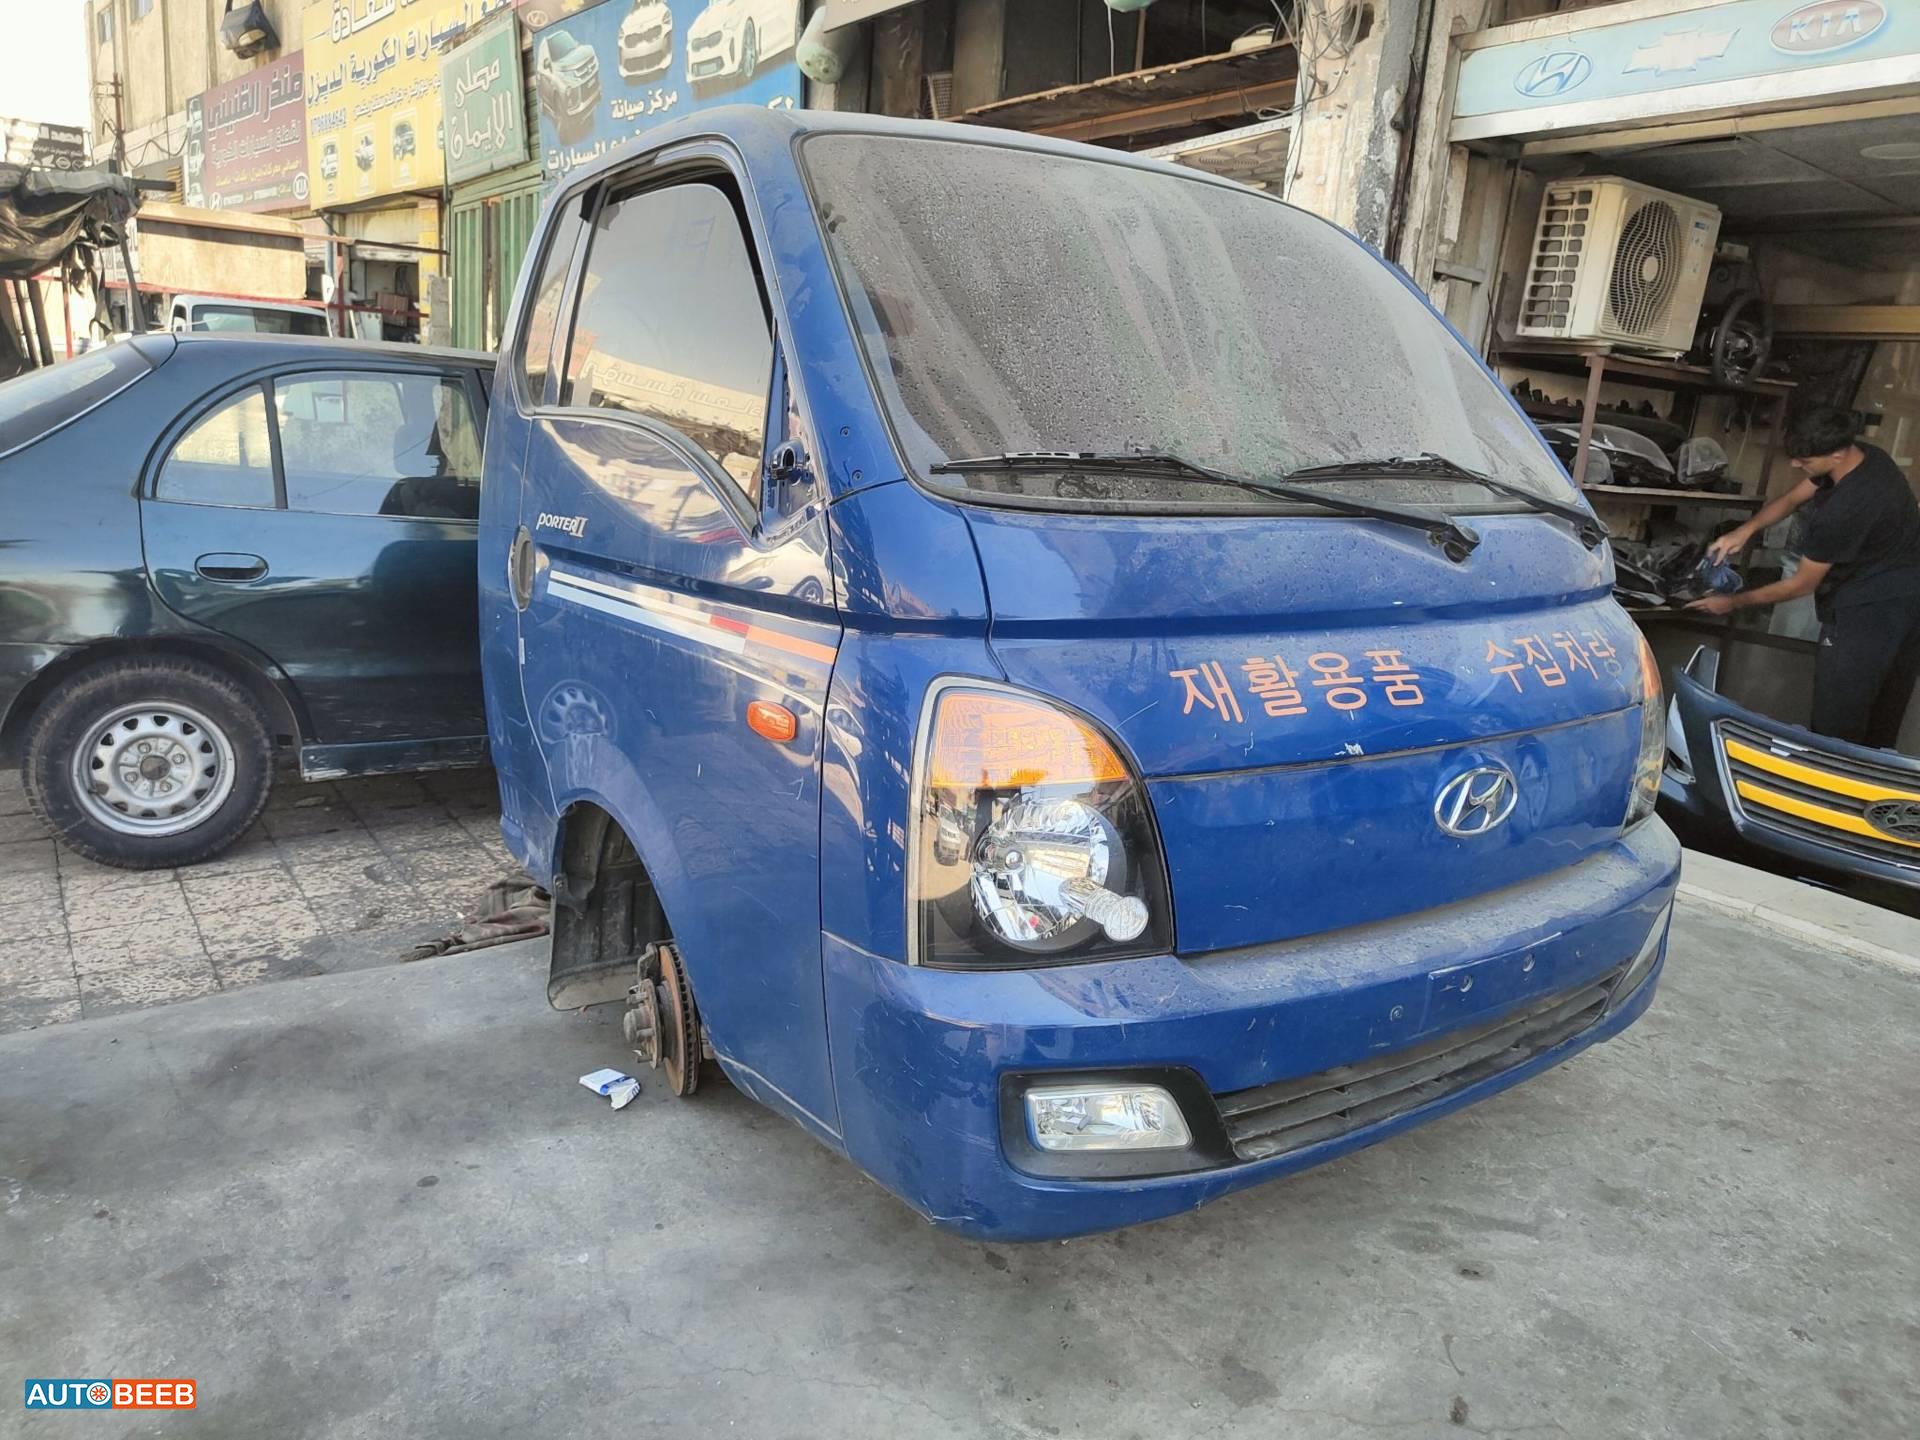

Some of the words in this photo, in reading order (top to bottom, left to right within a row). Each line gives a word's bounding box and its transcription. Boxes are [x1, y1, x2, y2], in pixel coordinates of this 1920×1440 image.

[1788, 6, 1862, 43] KIA
[350, 37, 402, 90] الكورية
[611, 99, 644, 120] صيانة
[647, 88, 678, 115] مركز
[547, 140, 607, 172] السيارات
[1168, 648, 1425, 724] 재활용품
[1485, 629, 1623, 694] 수집차량
